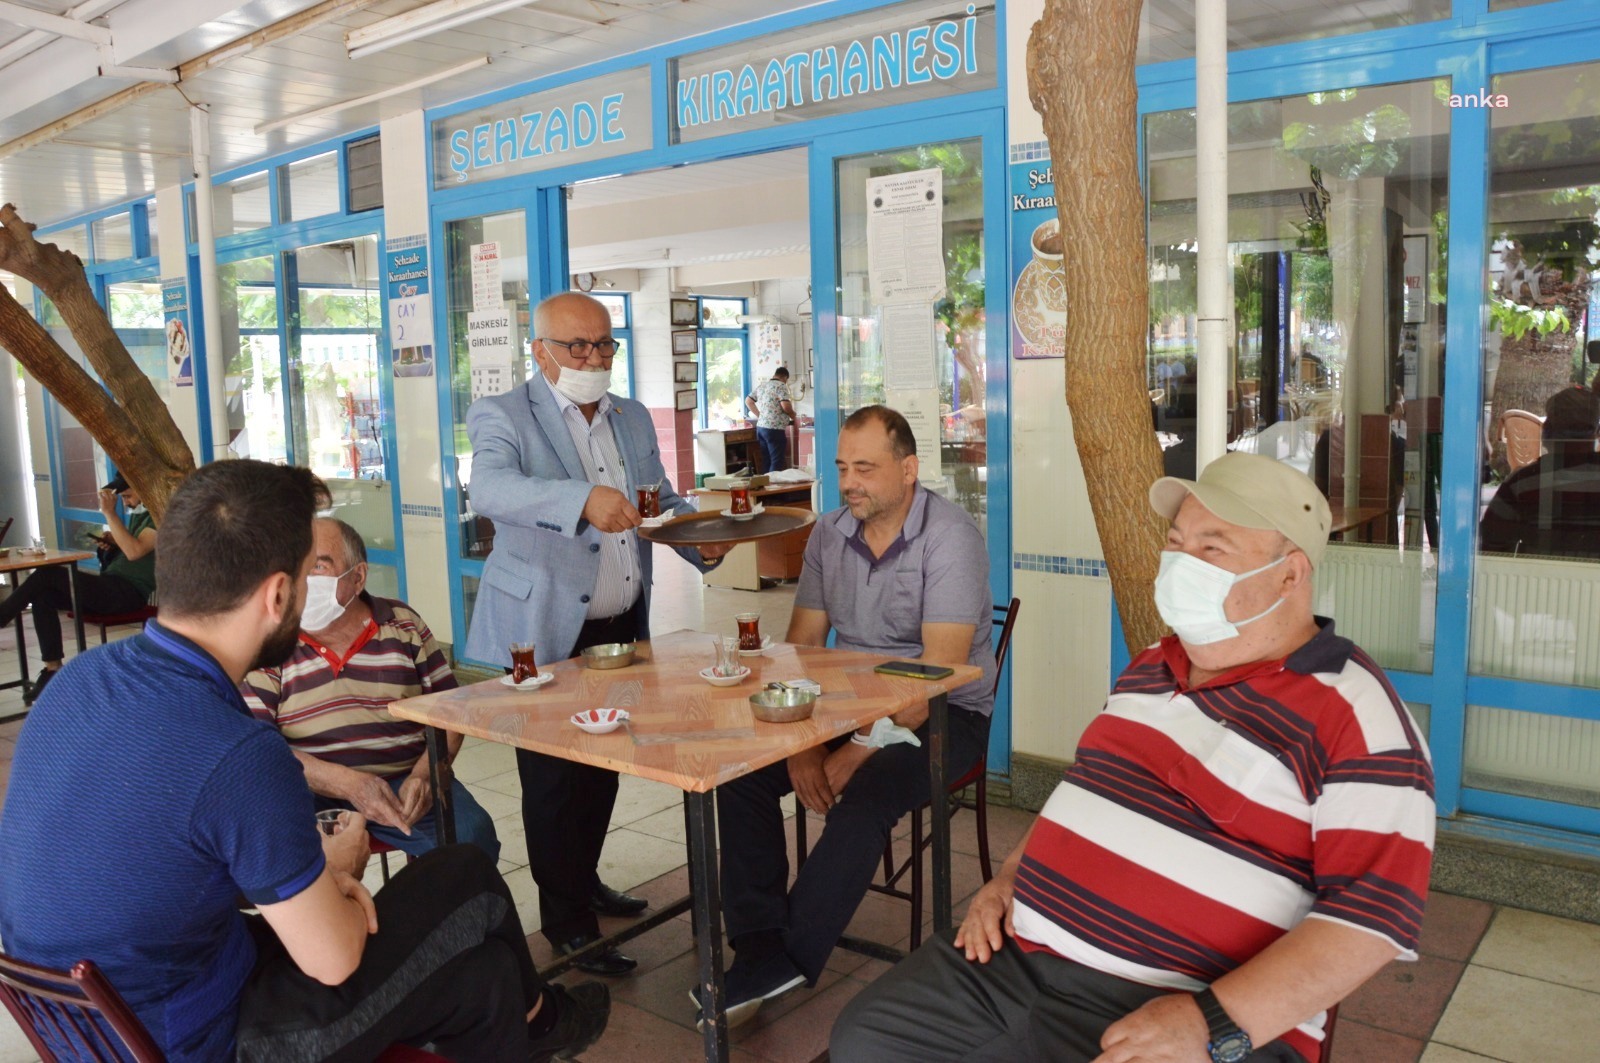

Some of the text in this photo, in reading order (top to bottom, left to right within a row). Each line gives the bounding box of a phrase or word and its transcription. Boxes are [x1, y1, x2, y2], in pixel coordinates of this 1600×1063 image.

[450, 3, 978, 183] ŞEHZADE KIRAATHANESİ
[1029, 167, 1055, 189] Şeh
[470, 318, 508, 330] MASKESİZ
[1041, 325, 1066, 338] Tü
[472, 336, 508, 347] GİRİLMEZ
[1021, 342, 1066, 357] Kah
